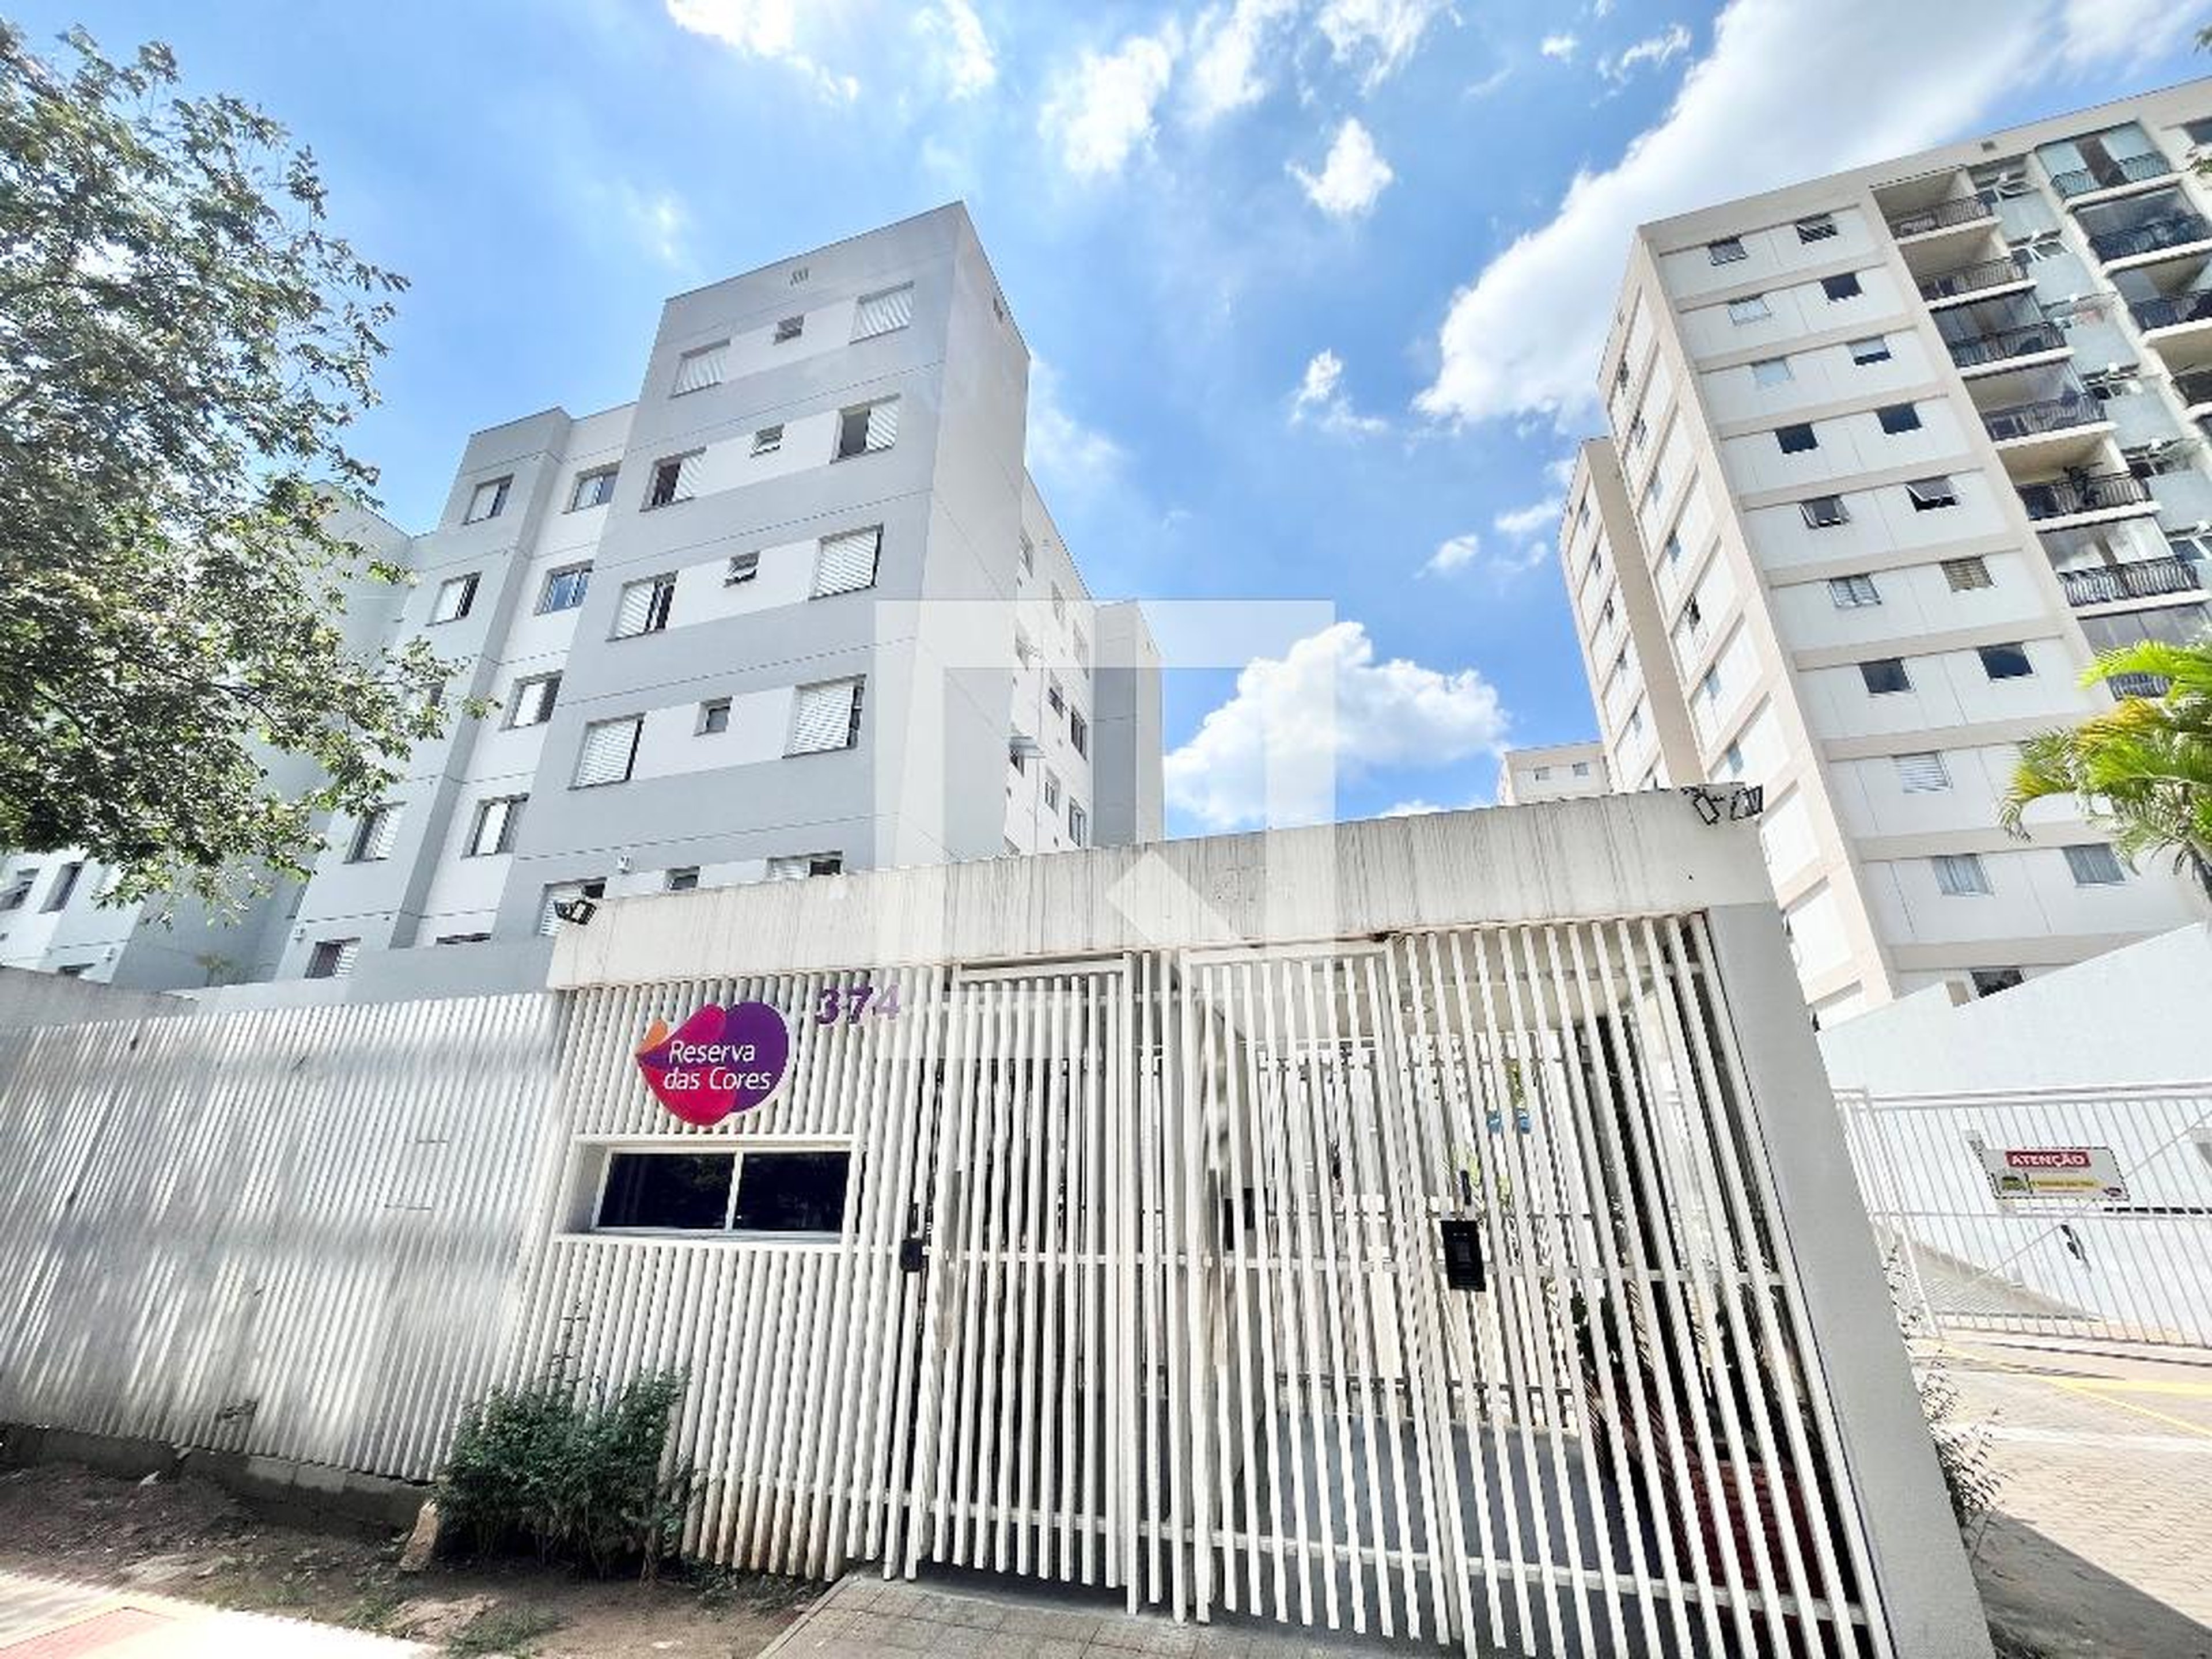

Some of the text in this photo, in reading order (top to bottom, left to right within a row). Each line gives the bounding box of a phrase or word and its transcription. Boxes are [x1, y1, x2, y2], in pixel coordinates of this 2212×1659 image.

[815, 983, 901, 1024] 374
[668, 1040, 755, 1064] Reserva
[664, 1067, 771, 1090] das Cores
[2012, 1153, 2086, 1167] ATENÇÃO
